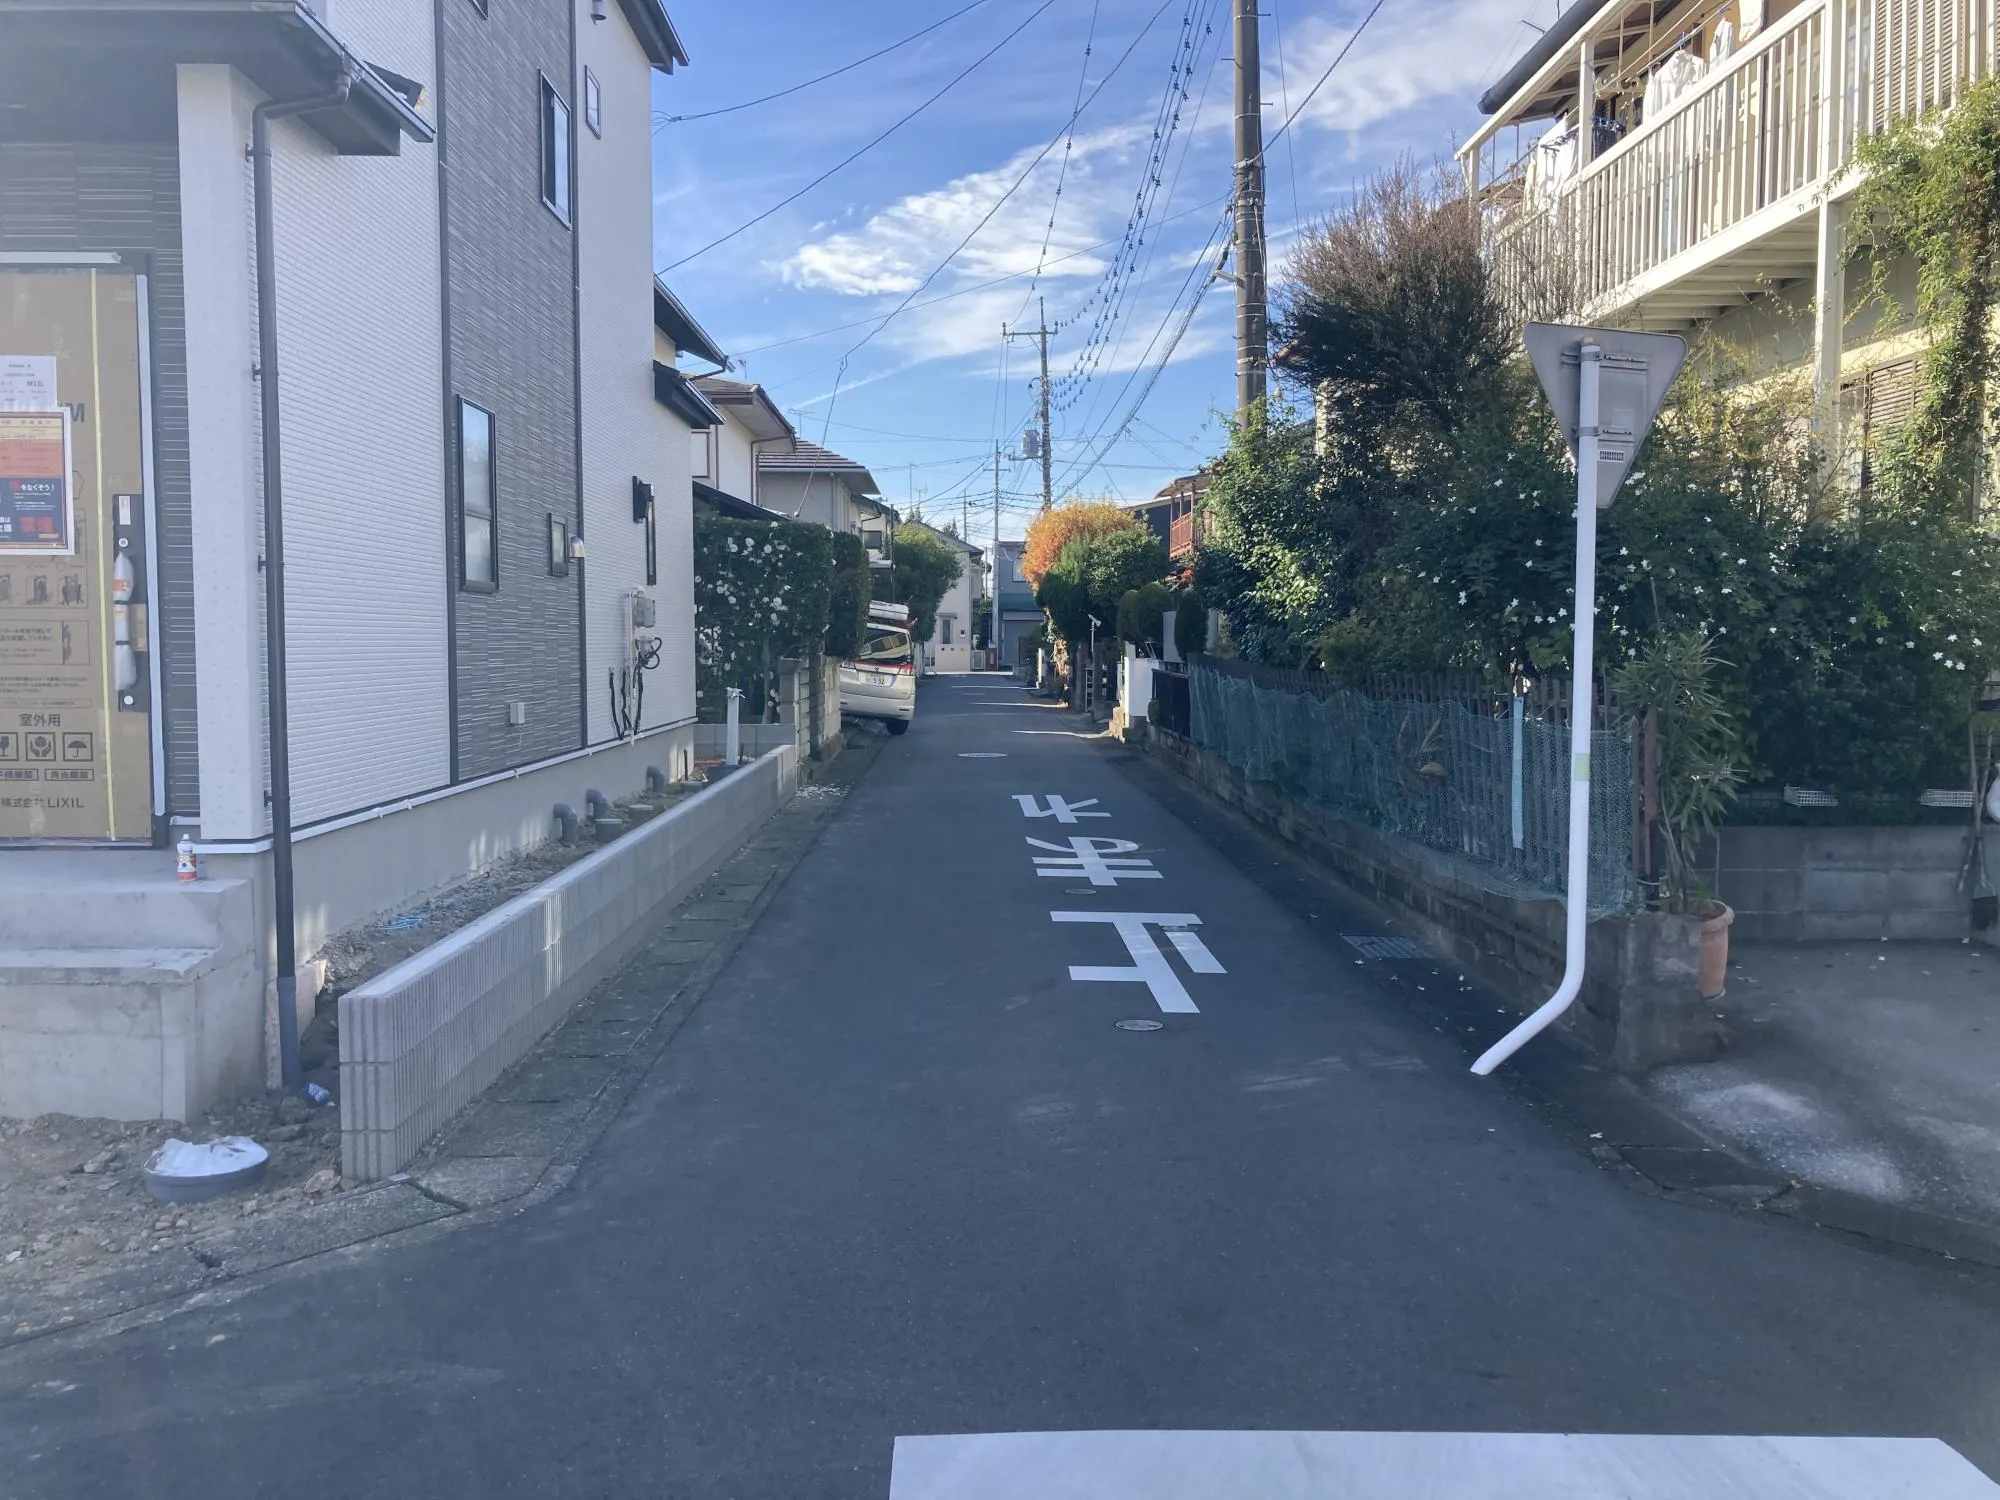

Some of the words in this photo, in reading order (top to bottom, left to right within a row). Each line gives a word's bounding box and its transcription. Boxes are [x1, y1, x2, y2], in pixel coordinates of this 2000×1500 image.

[19, 713, 61, 727] 室外用
[47, 797, 85, 808] LIXIL
[1012, 795, 1228, 1013] 止まれ
